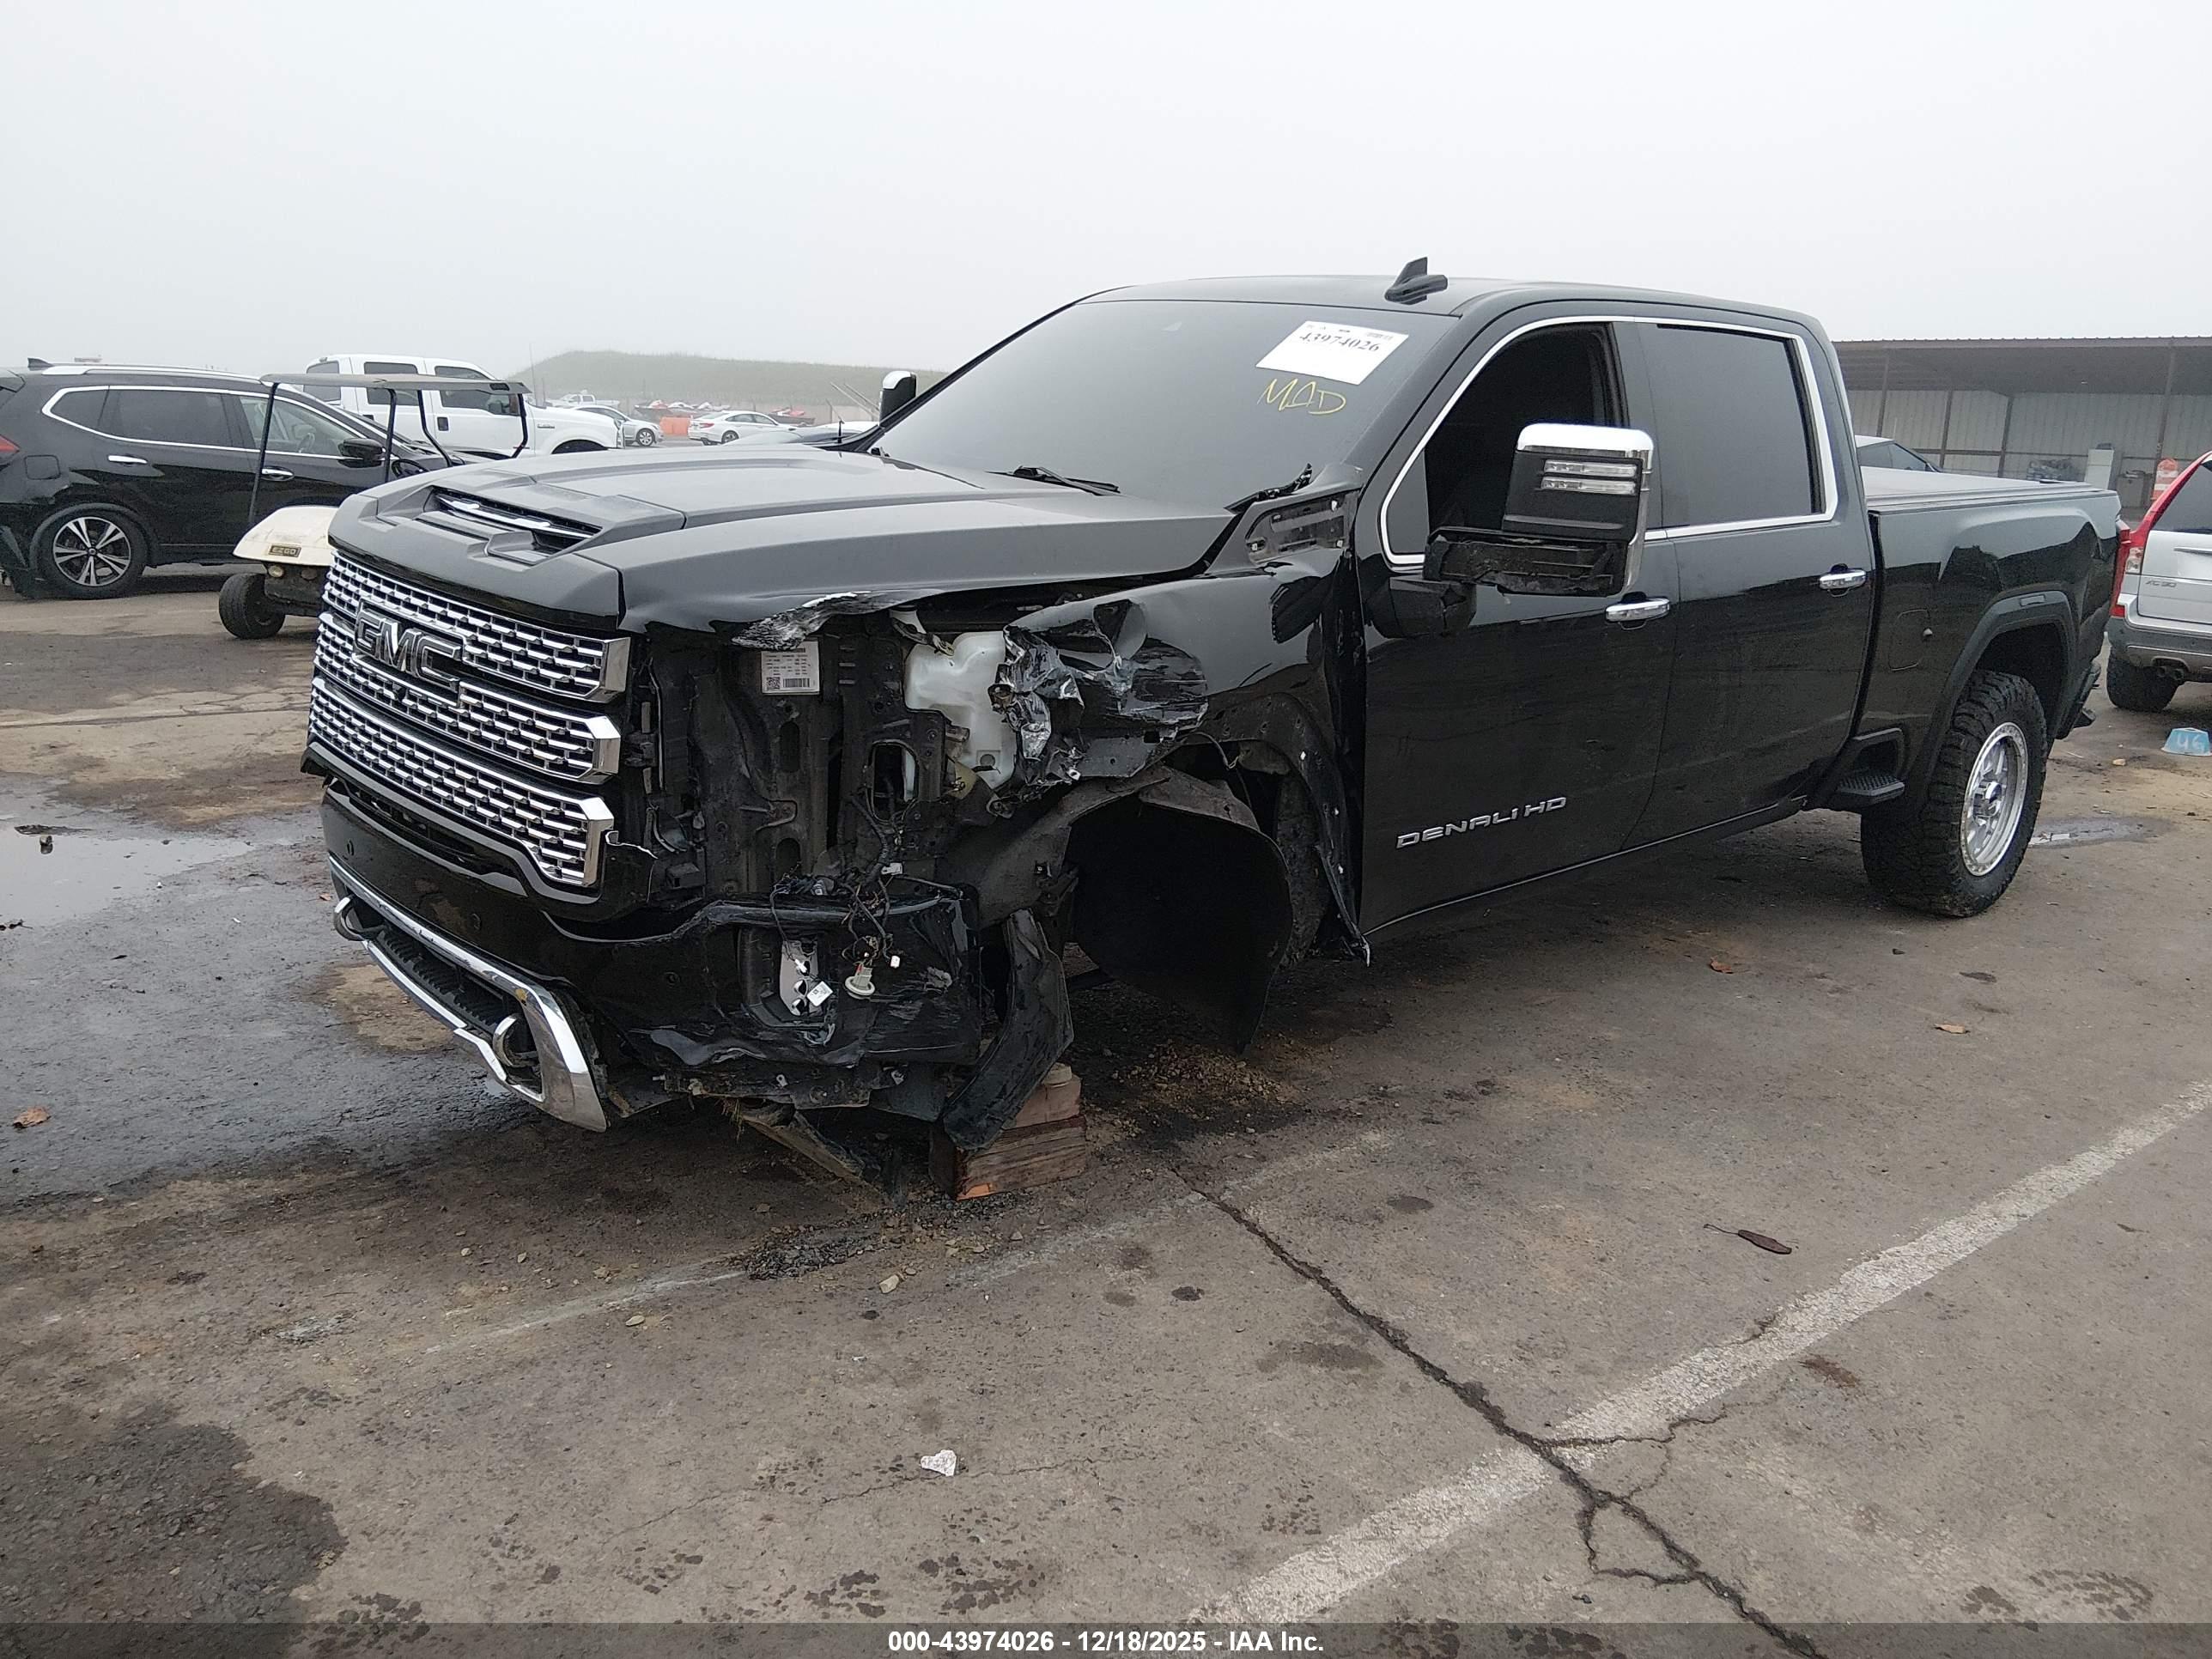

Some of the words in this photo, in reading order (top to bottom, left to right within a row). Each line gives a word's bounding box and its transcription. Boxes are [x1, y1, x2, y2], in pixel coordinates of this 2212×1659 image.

[1299, 331, 1380, 352] 43974026
[352, 606, 464, 685] GMC
[1395, 807, 1519, 849] DENALI
[1523, 797, 1567, 817] HD
